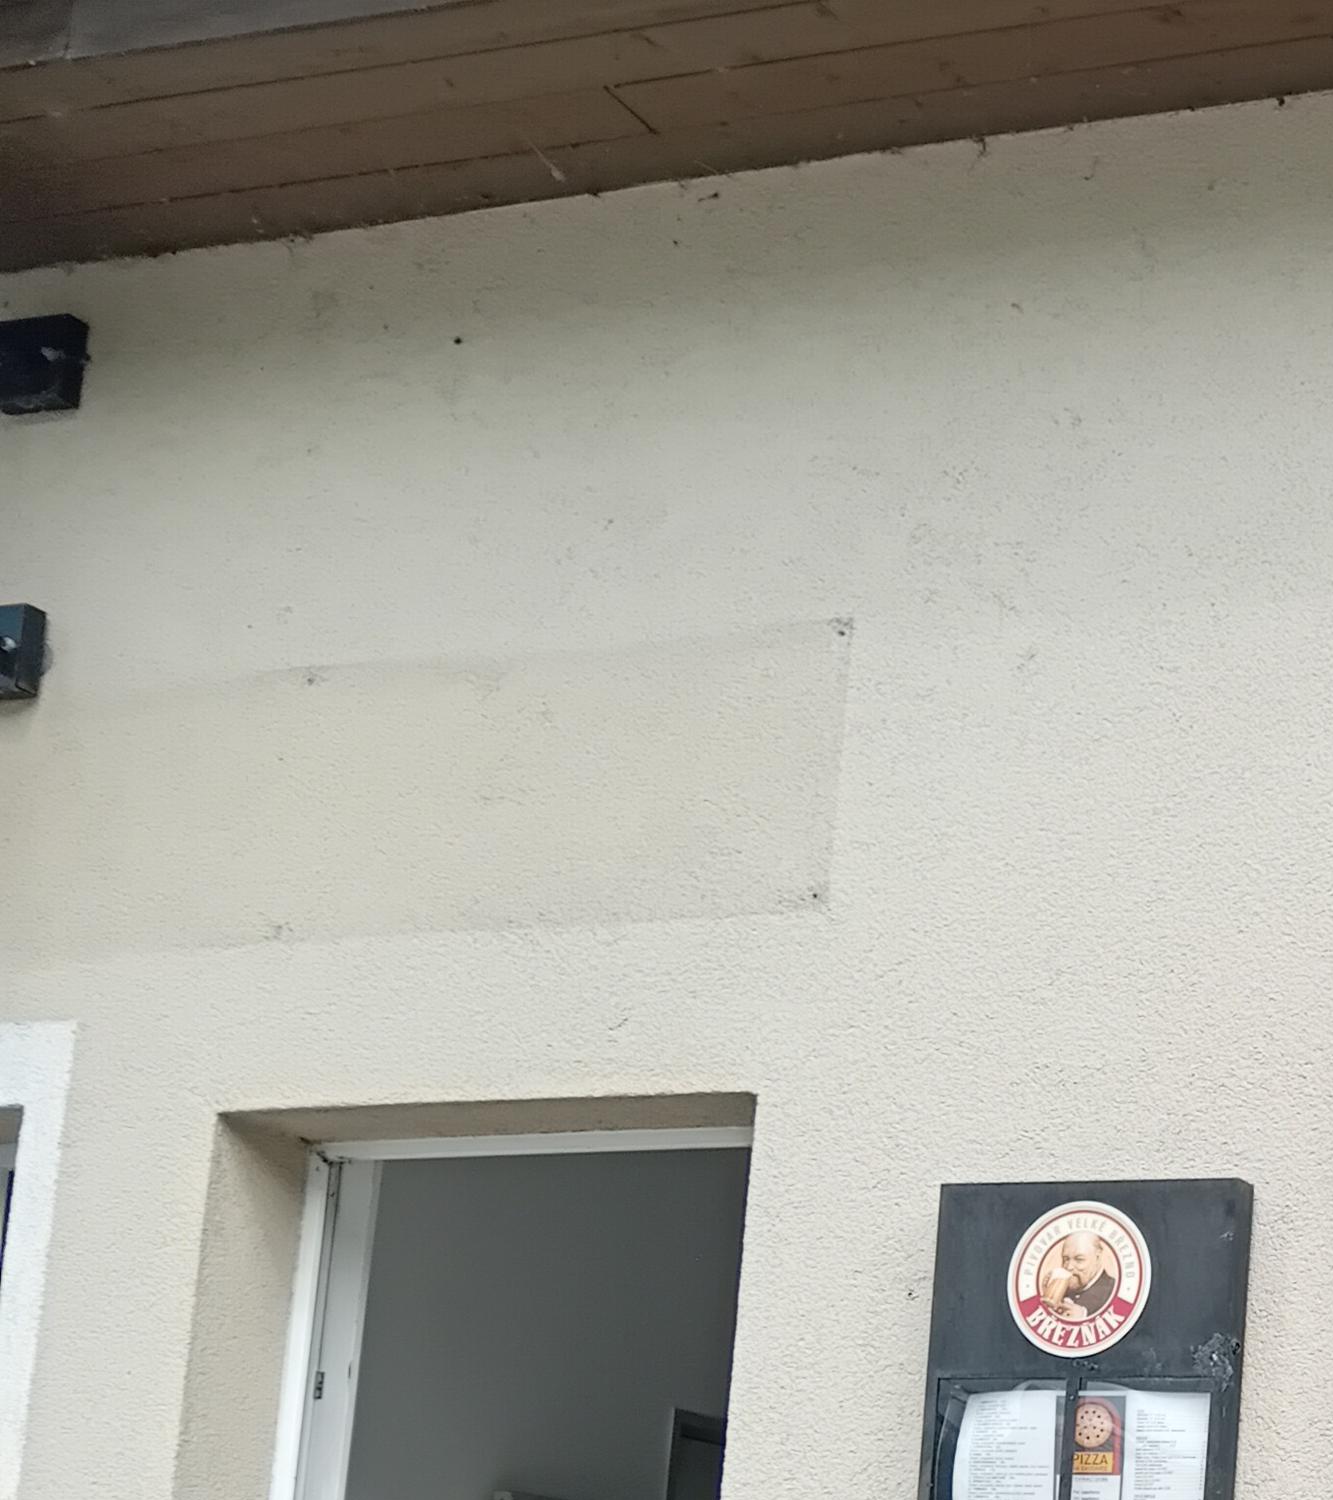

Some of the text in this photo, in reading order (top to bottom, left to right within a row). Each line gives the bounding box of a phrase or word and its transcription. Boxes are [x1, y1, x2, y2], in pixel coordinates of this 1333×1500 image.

[1024, 1217, 1135, 1278] PIVOVAR VELKÉ BŘEZNO
[1026, 1305, 1125, 1347] BŘEZŇÁK
[1073, 1454, 1108, 1465] PIZZA
